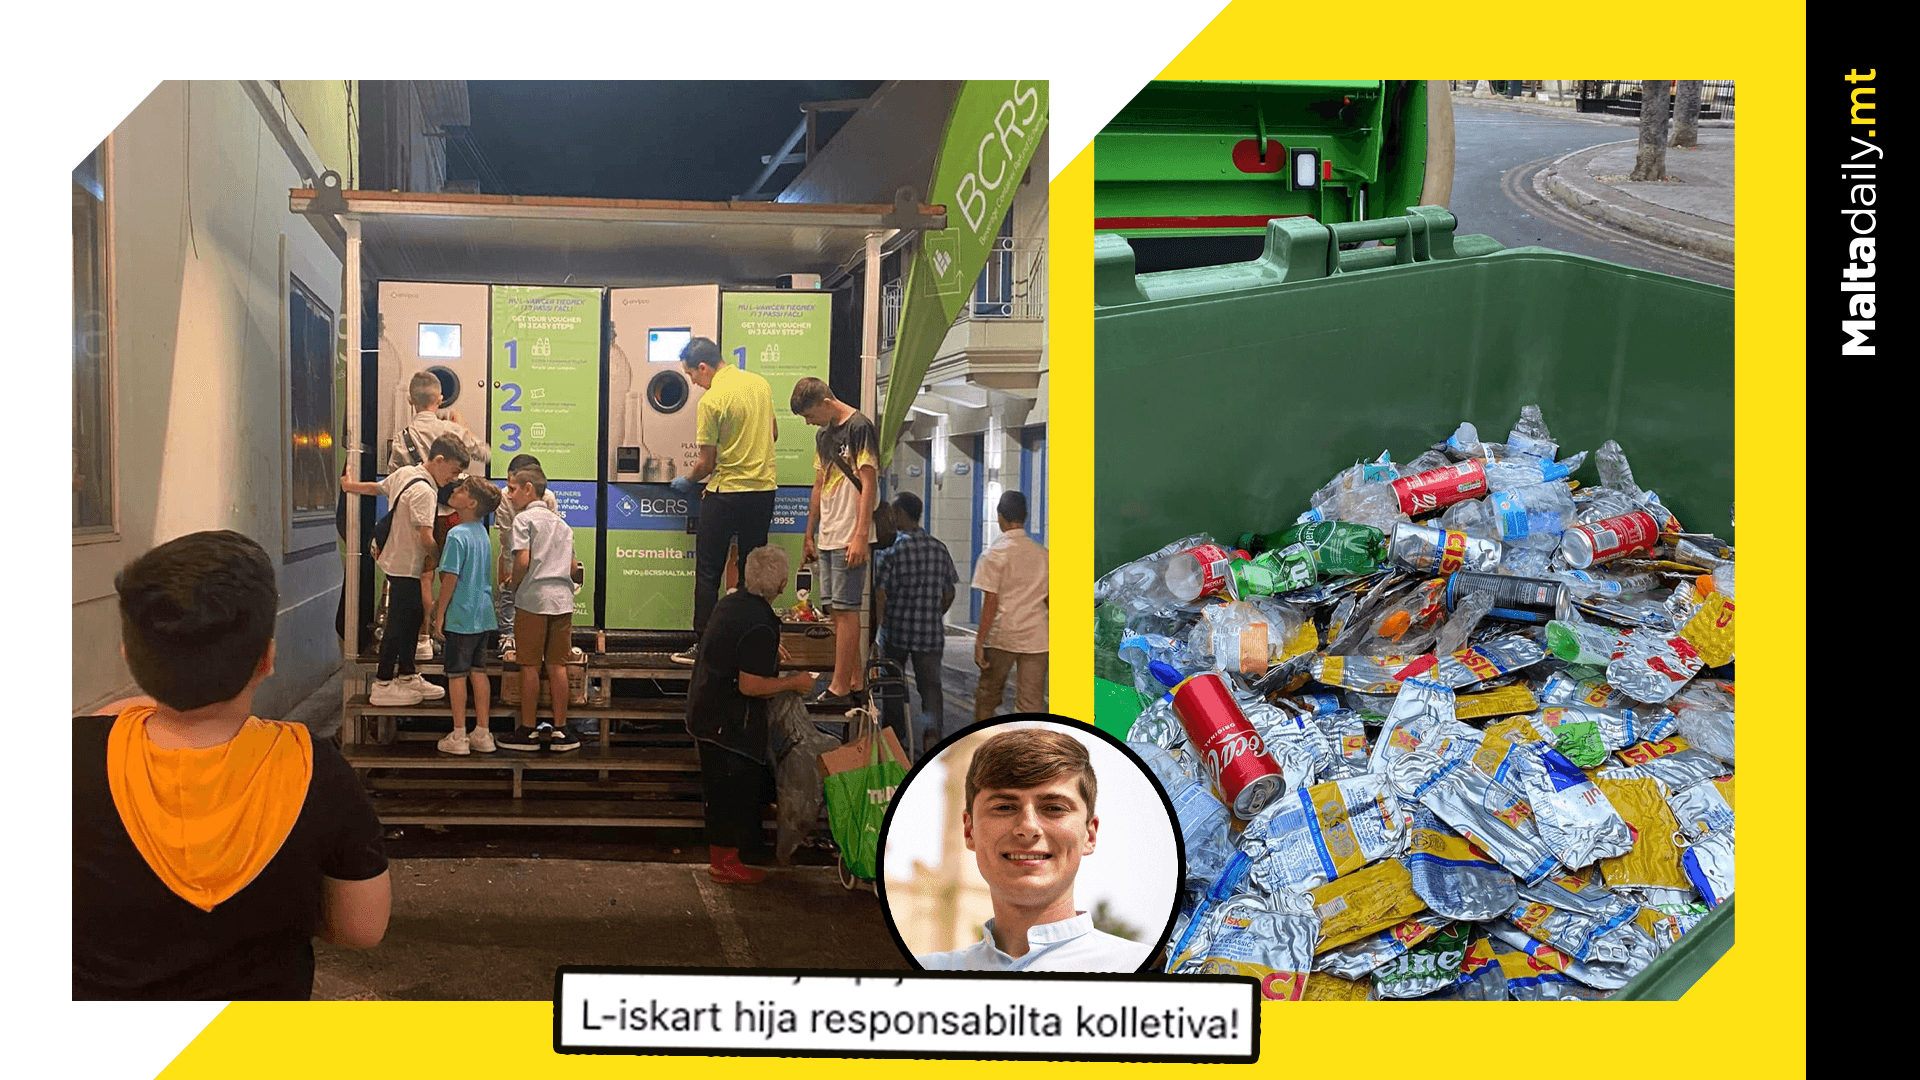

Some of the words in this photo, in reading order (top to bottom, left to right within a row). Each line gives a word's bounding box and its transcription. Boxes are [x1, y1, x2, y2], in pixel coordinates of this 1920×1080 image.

[956, 80, 1038, 233] BCRS
[504, 339, 517, 368] 1
[734, 346, 746, 370] 1
[500, 383, 522, 412] 2
[500, 423, 522, 452] 3
[640, 499, 688, 514] BCRS
[774, 516, 795, 524] 9955
[616, 546, 696, 558] bcrsmalta.m
[1590, 684, 1612, 702] CIS
[1204, 722, 1236, 747] ORIGINAL
[1624, 740, 1677, 764] CIS
[1668, 916, 1682, 936] CIS
[1262, 972, 1308, 1000] CI
